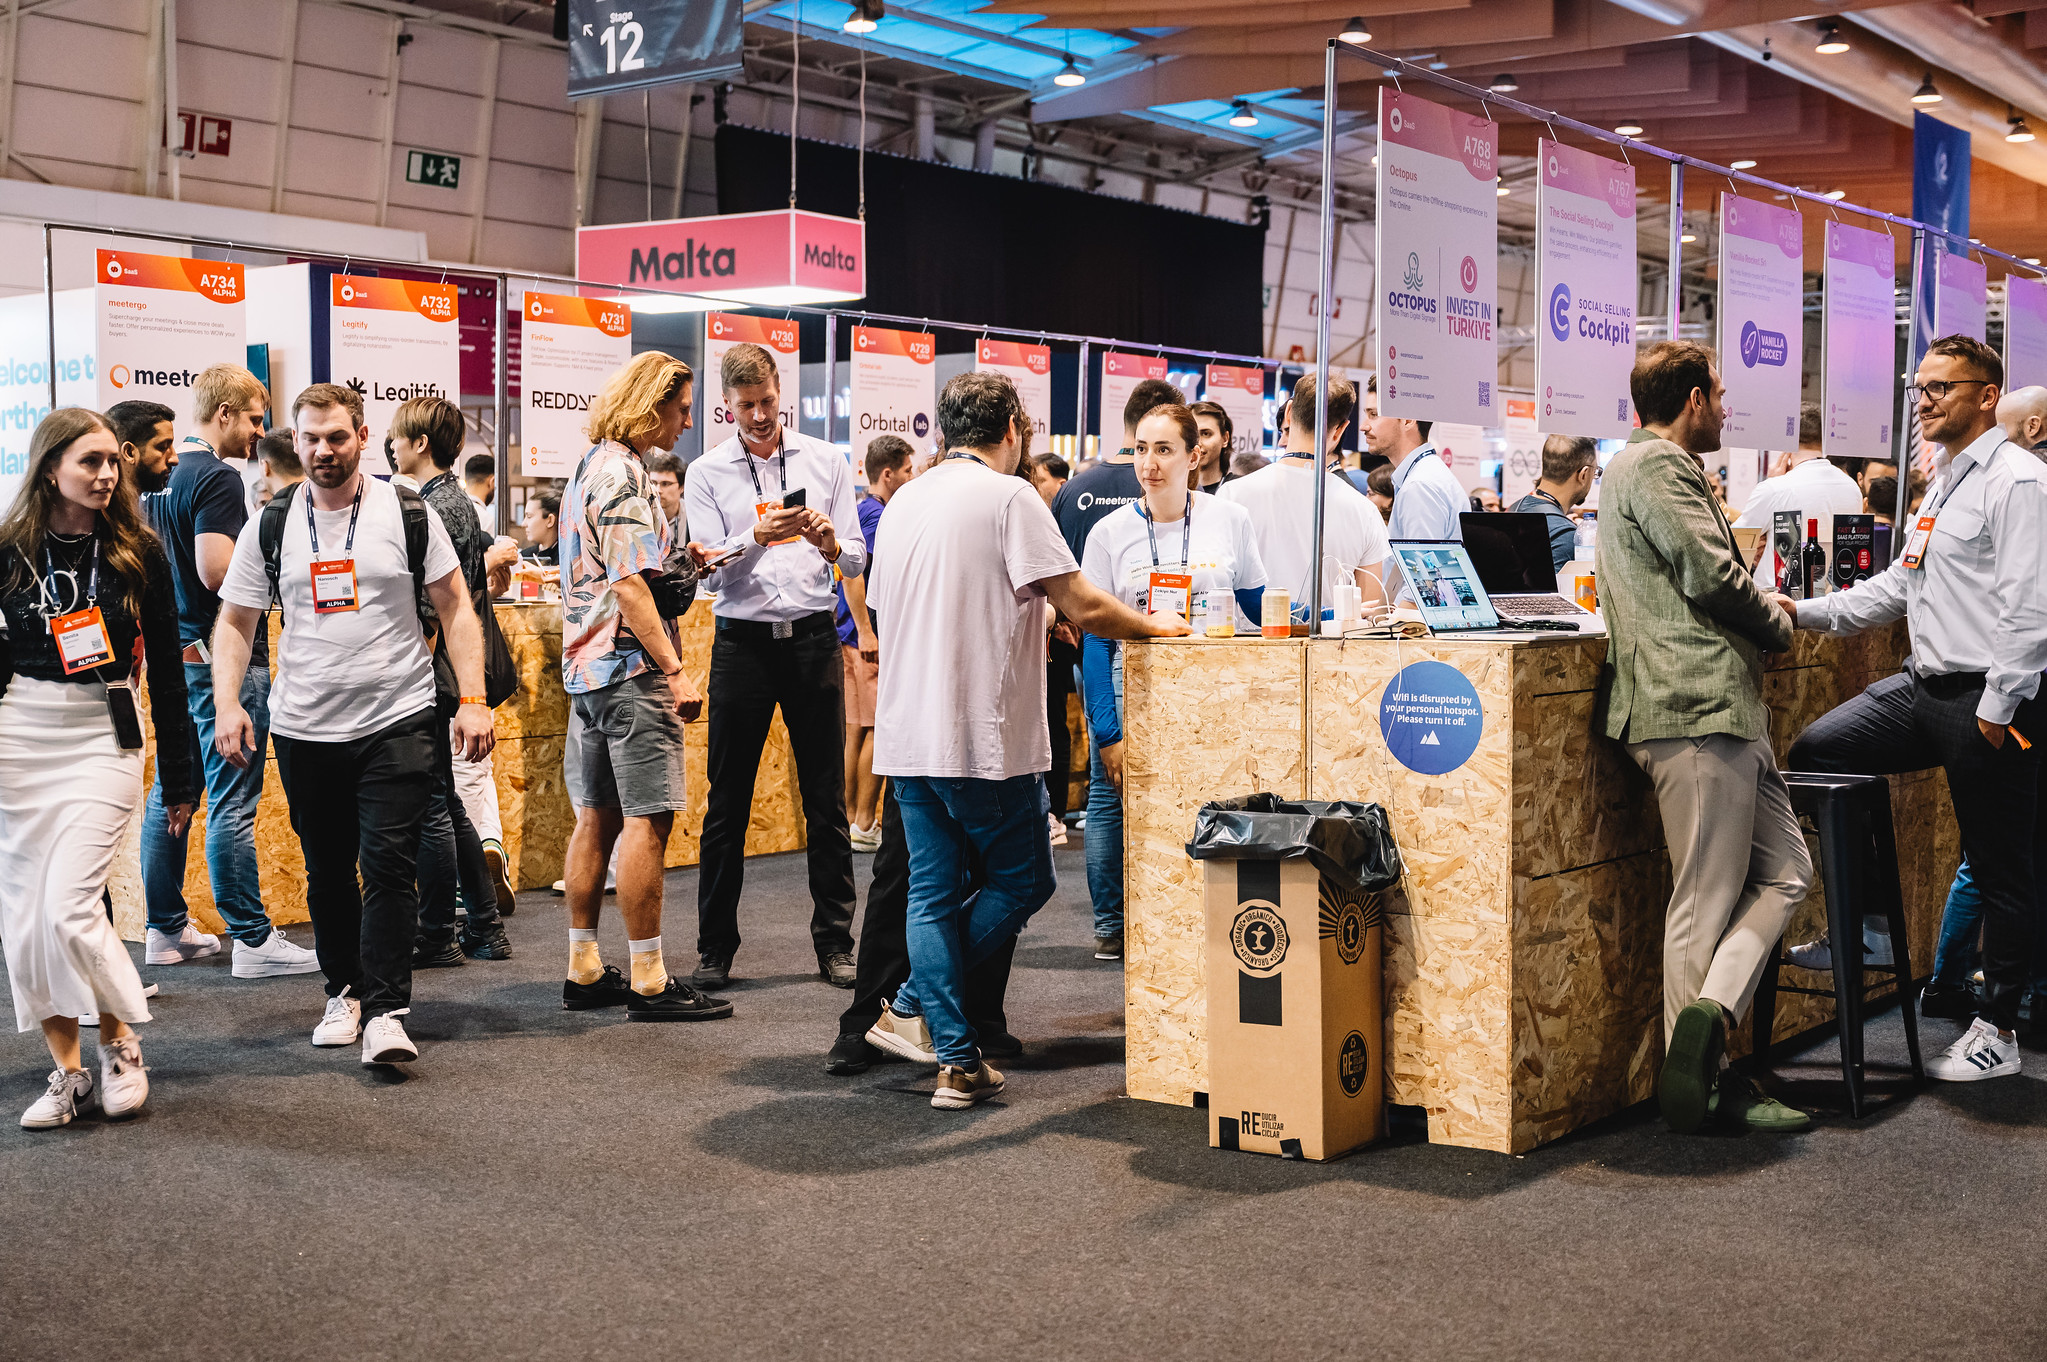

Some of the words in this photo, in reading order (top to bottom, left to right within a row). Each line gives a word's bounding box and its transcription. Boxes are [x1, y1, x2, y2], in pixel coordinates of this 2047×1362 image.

[610, 10, 633, 23] Stage
[600, 22, 644, 74] 12
[1404, 120, 1415, 129] SaaS
[1464, 136, 1490, 159] A768
[1473, 158, 1491, 170] ALPHA
[1390, 165, 1417, 181] Octopus
[1609, 178, 1630, 198] A767
[1390, 186, 1407, 198] Octopus
[1444, 200, 1462, 213] shopping
[1463, 206, 1483, 217] experience
[1398, 203, 1411, 211] Online
[1550, 206, 1560, 218] The
[1561, 209, 1576, 222] Social
[1577, 213, 1594, 229] Selling
[1595, 218, 1614, 232] Cockpit
[1779, 223, 1798, 242] A766
[629, 238, 735, 283] Malta
[804, 243, 855, 272] Malta
[201, 274, 236, 289] A734
[213, 289, 236, 297] ALPHA
[108, 300, 147, 310] meetergo
[421, 296, 450, 309] A732
[1389, 291, 1437, 314] OCTOPUS
[1446, 296, 1479, 318] INVEST
[1482, 303, 1491, 320] IN
[1579, 298, 1602, 312] SOCIAL
[1605, 304, 1630, 317] SELLING
[109, 313, 141, 321] Supercharge
[600, 312, 624, 325] A731
[1390, 309, 1400, 317] More
[1400, 310, 1409, 318] Than
[1410, 312, 1421, 320] Digital
[1422, 313, 1436, 323] Signage
[140, 324, 172, 332] personalized
[174, 327, 203, 335] experiences
[342, 320, 368, 330] Legitify
[1579, 315, 1630, 346] Cockpit
[531, 334, 554, 342] FinFlow
[771, 330, 794, 342] A730
[1761, 334, 1784, 348] VANILLA
[909, 342, 930, 354] A729
[1027, 354, 1046, 364] A728
[1761, 349, 1782, 361] ROCKET
[860, 413, 910, 432] Orbital
[915, 418, 927, 430] lab
[78, 656, 100, 666] ALPHA
[1393, 693, 1409, 701] Wifi
[1411, 694, 1417, 702] is
[1420, 694, 1459, 704] disrupted
[1462, 696, 1472, 706] by
[1385, 705, 1405, 713] your
[1406, 705, 1442, 714] personal
[1444, 706, 1479, 716] hotspot.
[1397, 714, 1423, 723] Please
[1445, 717, 1451, 725] it
[1453, 717, 1466, 726] off.
[1235, 921, 1245, 947] ORGANIC
[1343, 1052, 1353, 1076] RE
[1242, 1111, 1261, 1136] RE
[1262, 1113, 1276, 1121] DUCIR
[1262, 1121, 1284, 1130] UTILIZAR
[1262, 1129, 1280, 1138] CICLAR
